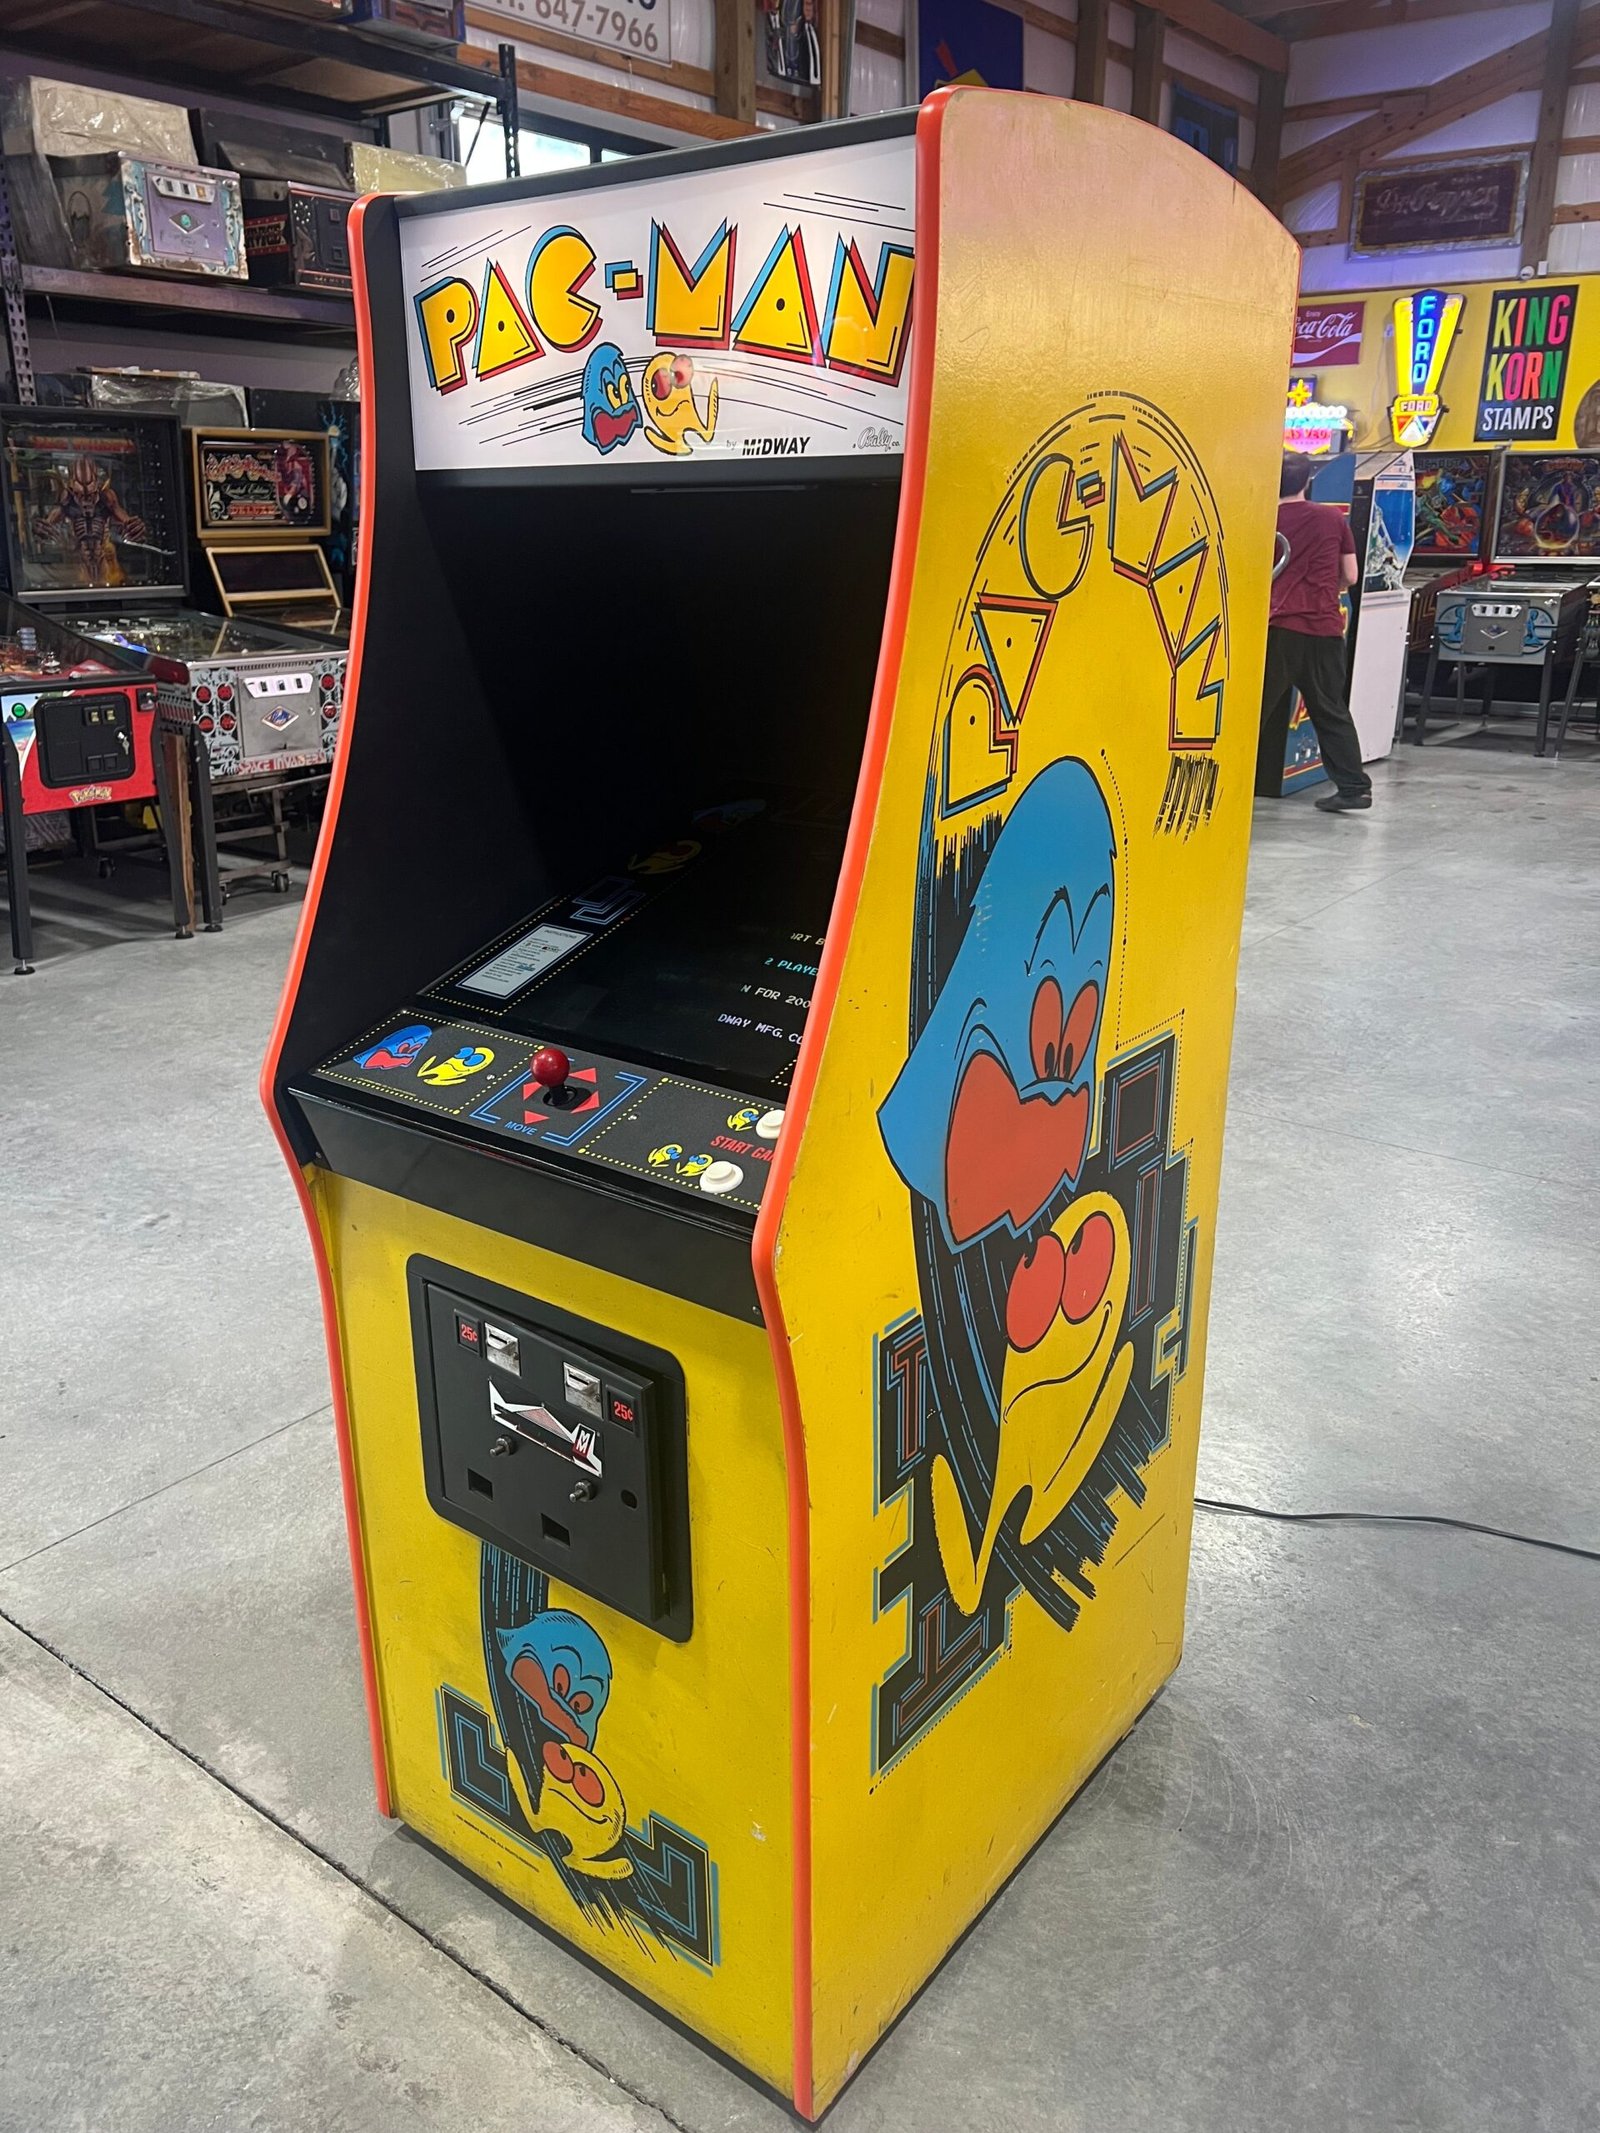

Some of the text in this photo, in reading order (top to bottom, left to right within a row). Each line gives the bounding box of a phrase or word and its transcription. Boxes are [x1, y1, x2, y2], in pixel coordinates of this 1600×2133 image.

[535, 0, 658, 52] 647-7966
[413, 217, 915, 396] PAC-MAN
[1492, 294, 1571, 348] KING
[1412, 295, 1437, 384] FORD
[1485, 350, 1563, 402] KORN
[1400, 400, 1433, 412] FORD
[1482, 405, 1554, 431] STAMPS
[726, 436, 811, 456] by MIDWAY
[857, 426, 893, 452] Bally
[237, 759, 271, 776] SPACE
[764, 957, 820, 976] 2 PLAYE
[754, 987, 781, 1000] FOR
[718, 1013, 752, 1028] DWAY
[755, 1022, 784, 1039] MFG.
[504, 1120, 538, 1136] MOVE
[710, 1135, 754, 1155] START
